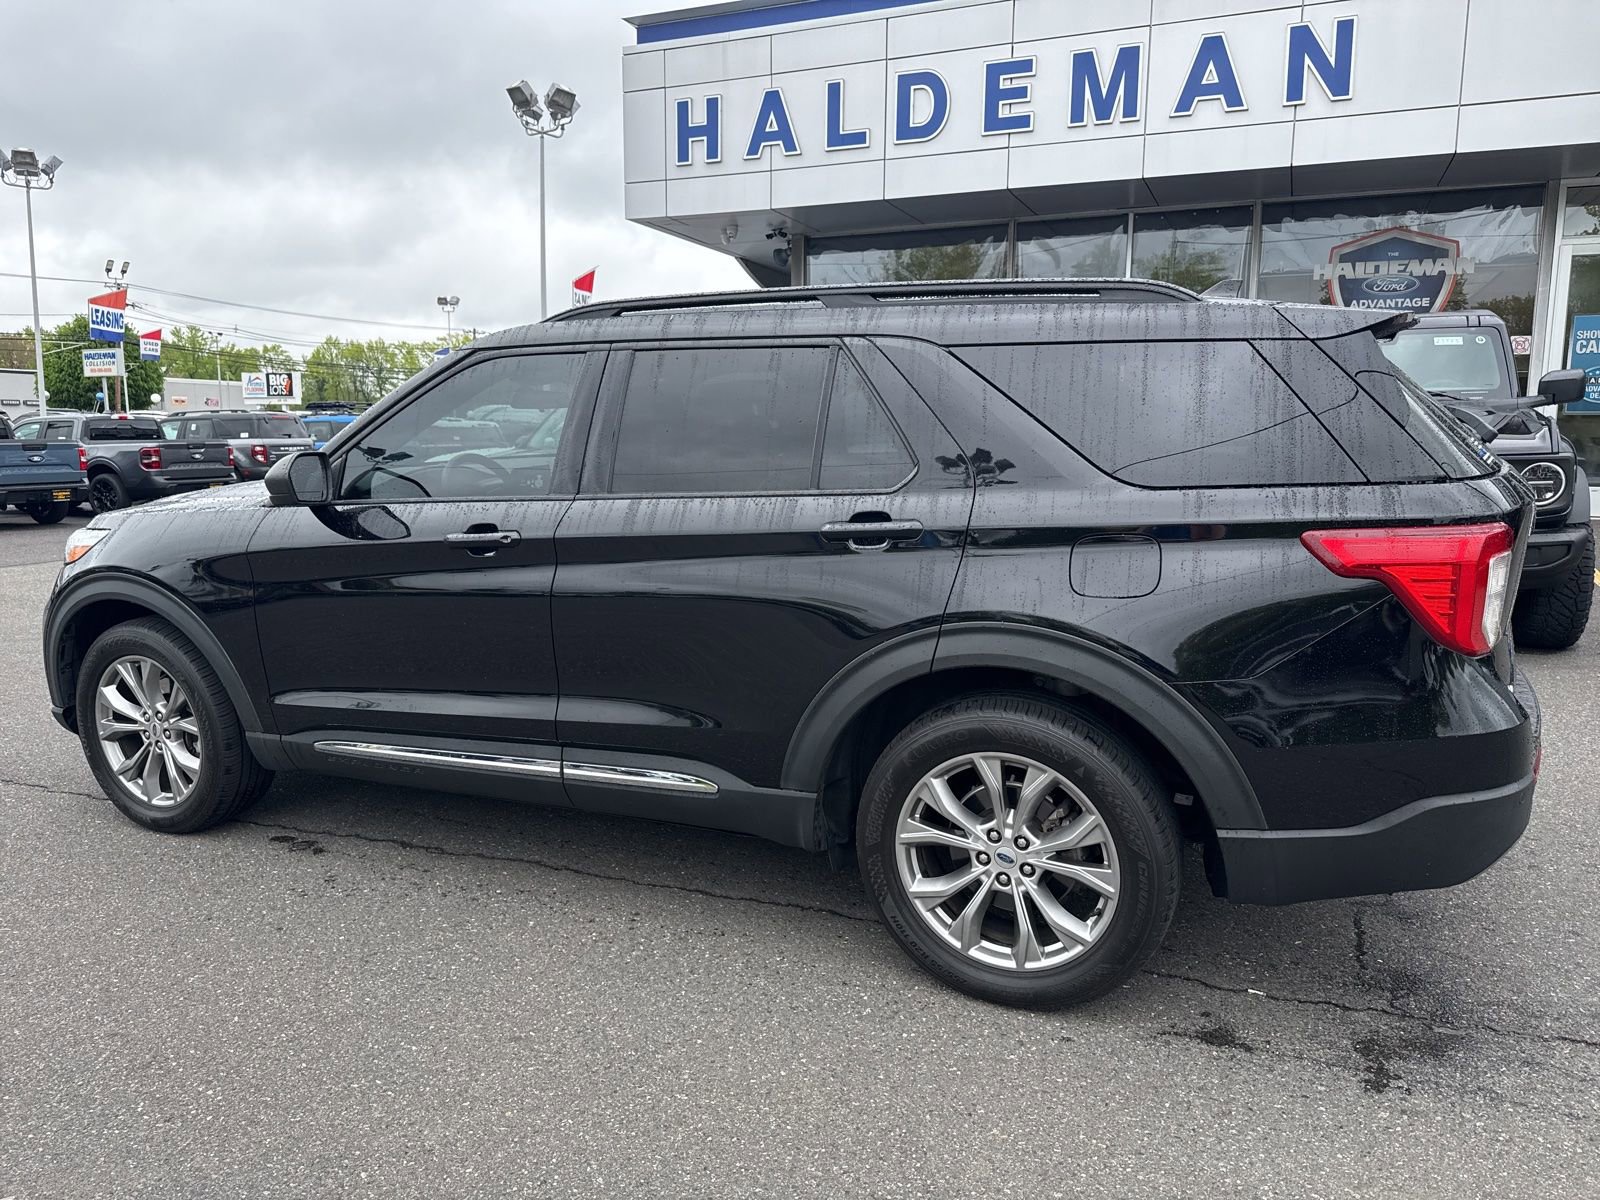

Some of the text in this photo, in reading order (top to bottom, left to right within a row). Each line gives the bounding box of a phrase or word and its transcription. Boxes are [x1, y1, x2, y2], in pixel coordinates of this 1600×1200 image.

[675, 15, 1358, 167] HALDEMAN
[1373, 276, 1408, 292] Ford
[1350, 297, 1431, 309] ADVANTAGE
[91, 307, 124, 330] LEASING
[1576, 330, 1600, 340] SHO
[1575, 339, 1600, 354] CA
[269, 374, 289, 386] BIG
